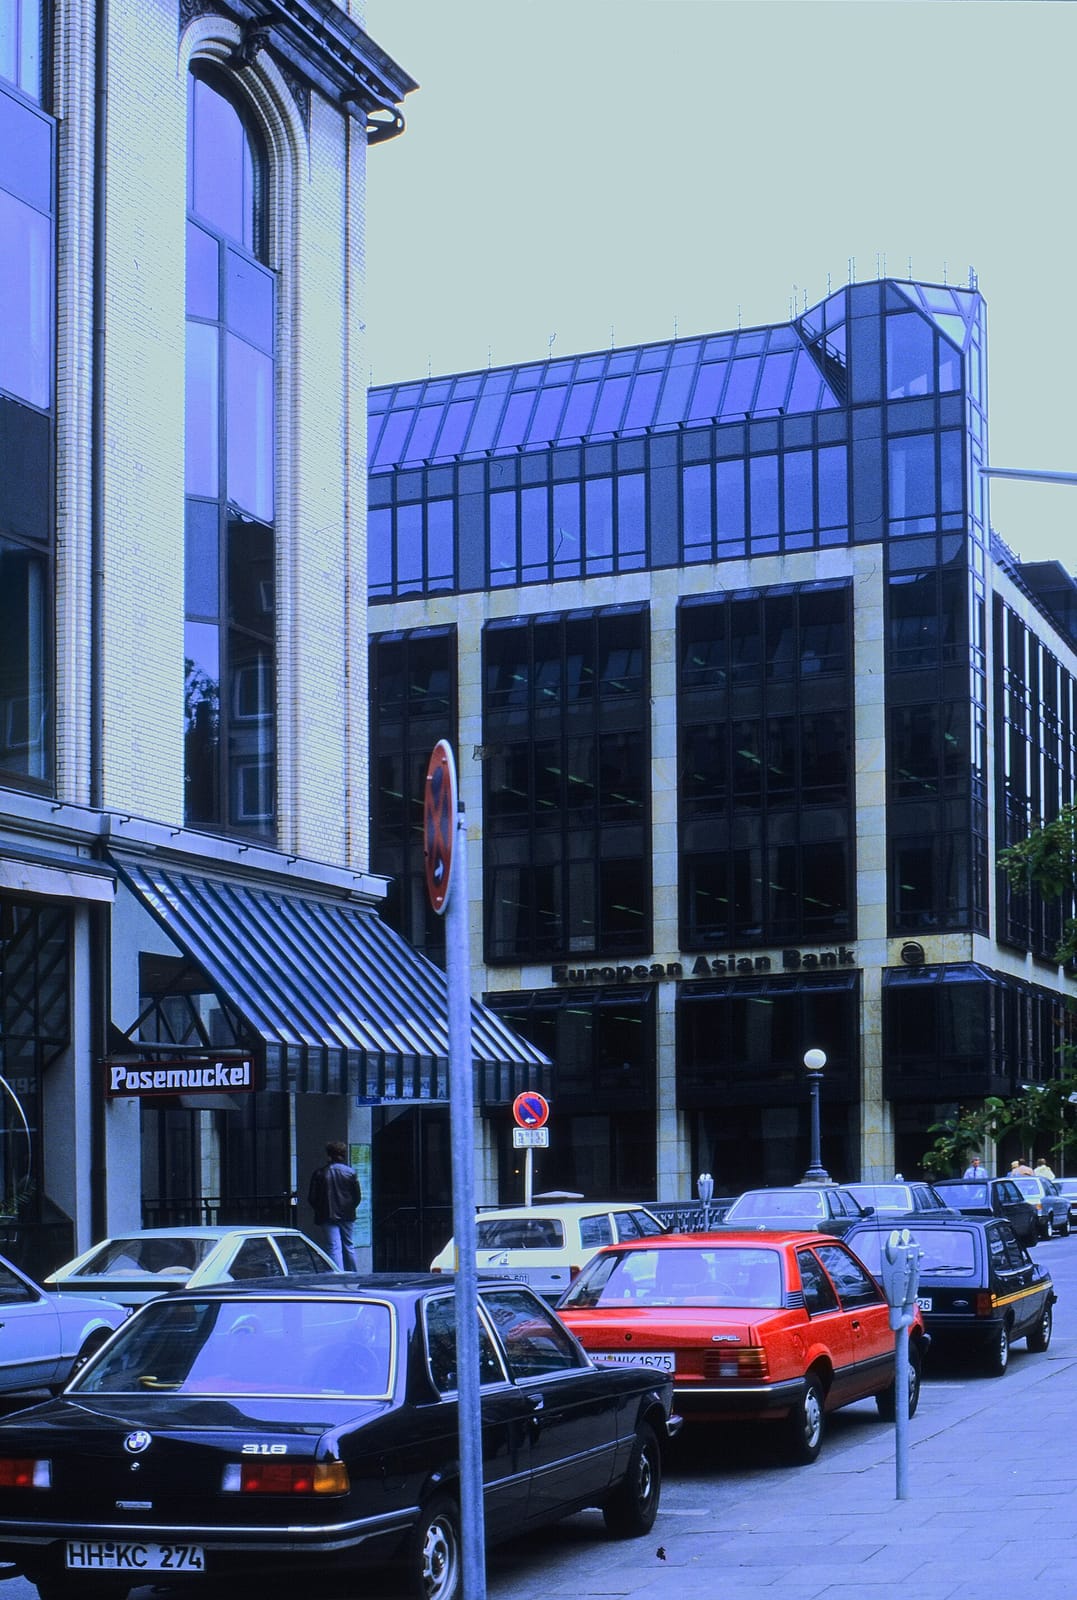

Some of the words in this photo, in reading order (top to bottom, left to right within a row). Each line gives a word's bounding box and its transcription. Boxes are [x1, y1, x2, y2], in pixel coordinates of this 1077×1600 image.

[551, 961, 682, 984] European
[691, 954, 772, 975] Asian
[782, 947, 856, 969] Bank
[110, 1061, 250, 1090] Posemuckel
[241, 1443, 288, 1455] 318
[159, 1545, 202, 1569] 274
